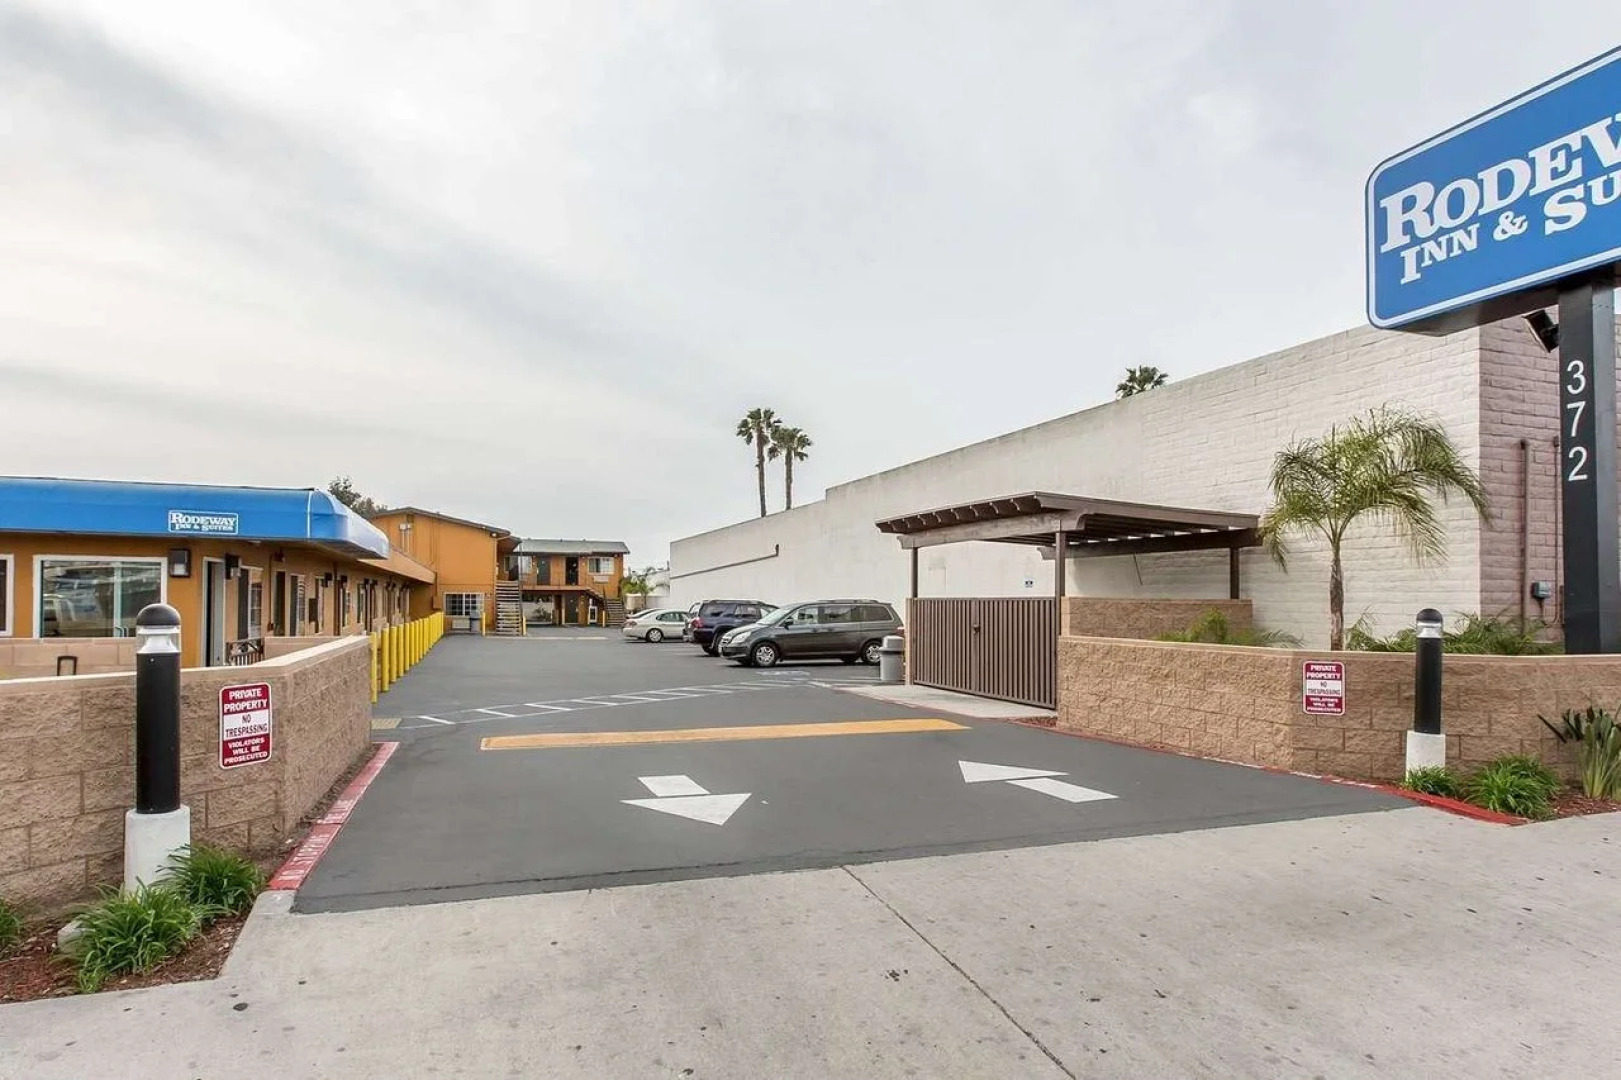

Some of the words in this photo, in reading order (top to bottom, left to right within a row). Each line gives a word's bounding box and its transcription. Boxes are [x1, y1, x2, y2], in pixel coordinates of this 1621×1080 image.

[1400, 223, 1481, 285] INN
[1493, 211, 1529, 242] &
[171, 512, 235, 525] RODEWAY
[1310, 664, 1337, 672] PRIVATE
[1306, 671, 1341, 680] PROPERTY
[228, 688, 263, 701] PRIVATE
[223, 698, 268, 713] PROPERTY
[242, 714, 252, 724] NO
[225, 723, 268, 738] TRESPASSING
[227, 737, 266, 749] VIOLATORS
[232, 747, 250, 756] WILL
[250, 745, 260, 753] BE
[223, 751, 268, 765] PROSECUTED
